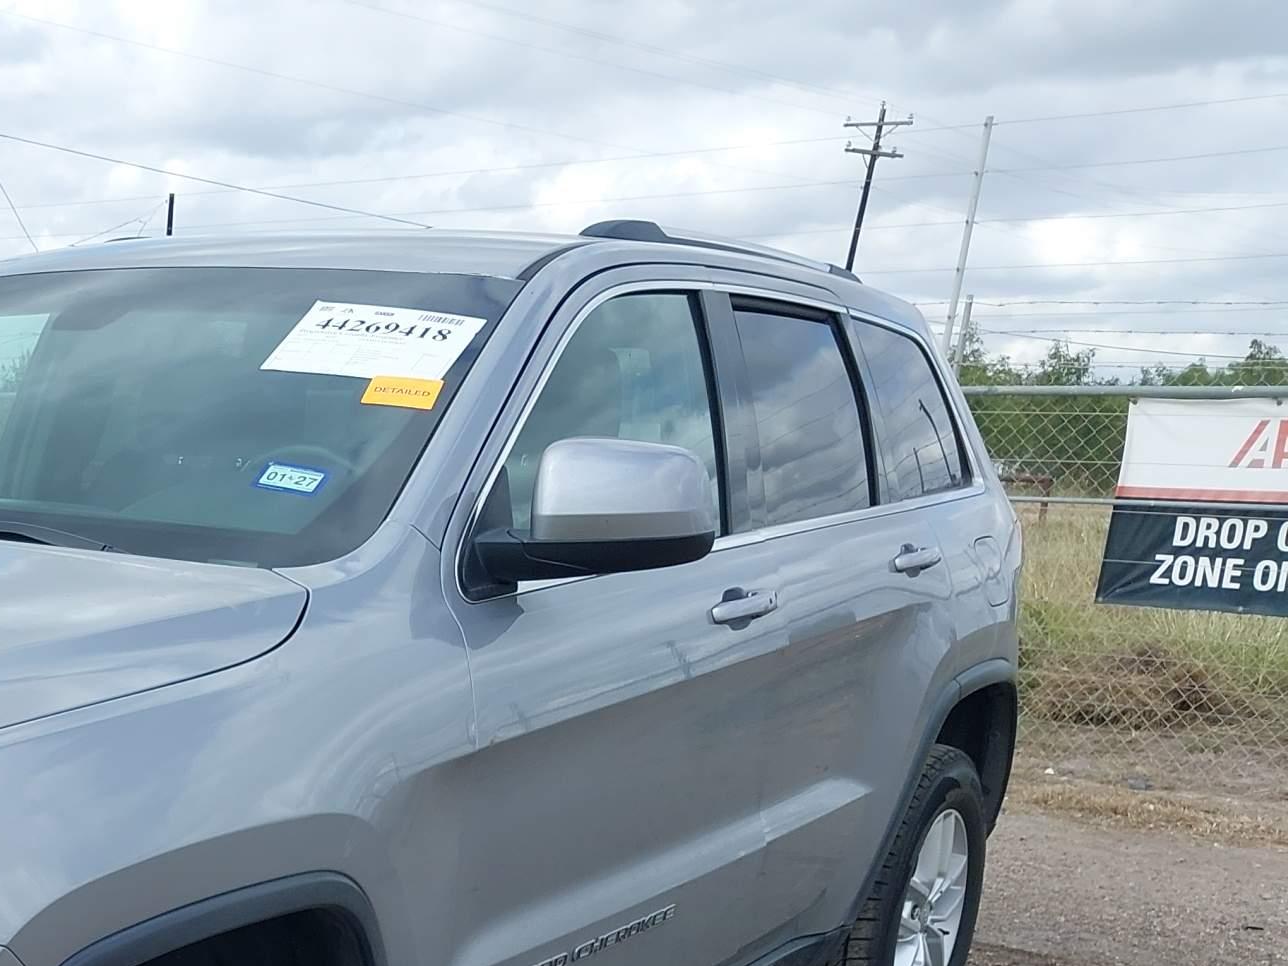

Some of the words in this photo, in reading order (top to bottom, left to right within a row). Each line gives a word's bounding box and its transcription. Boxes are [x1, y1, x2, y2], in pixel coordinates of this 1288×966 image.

[316, 317, 452, 342] 44269418
[374, 386, 431, 398] DETAILED
[1172, 516, 1268, 550] DROP
[1149, 554, 1245, 590] ZONE
[570, 904, 677, 963] CHEROKEE
